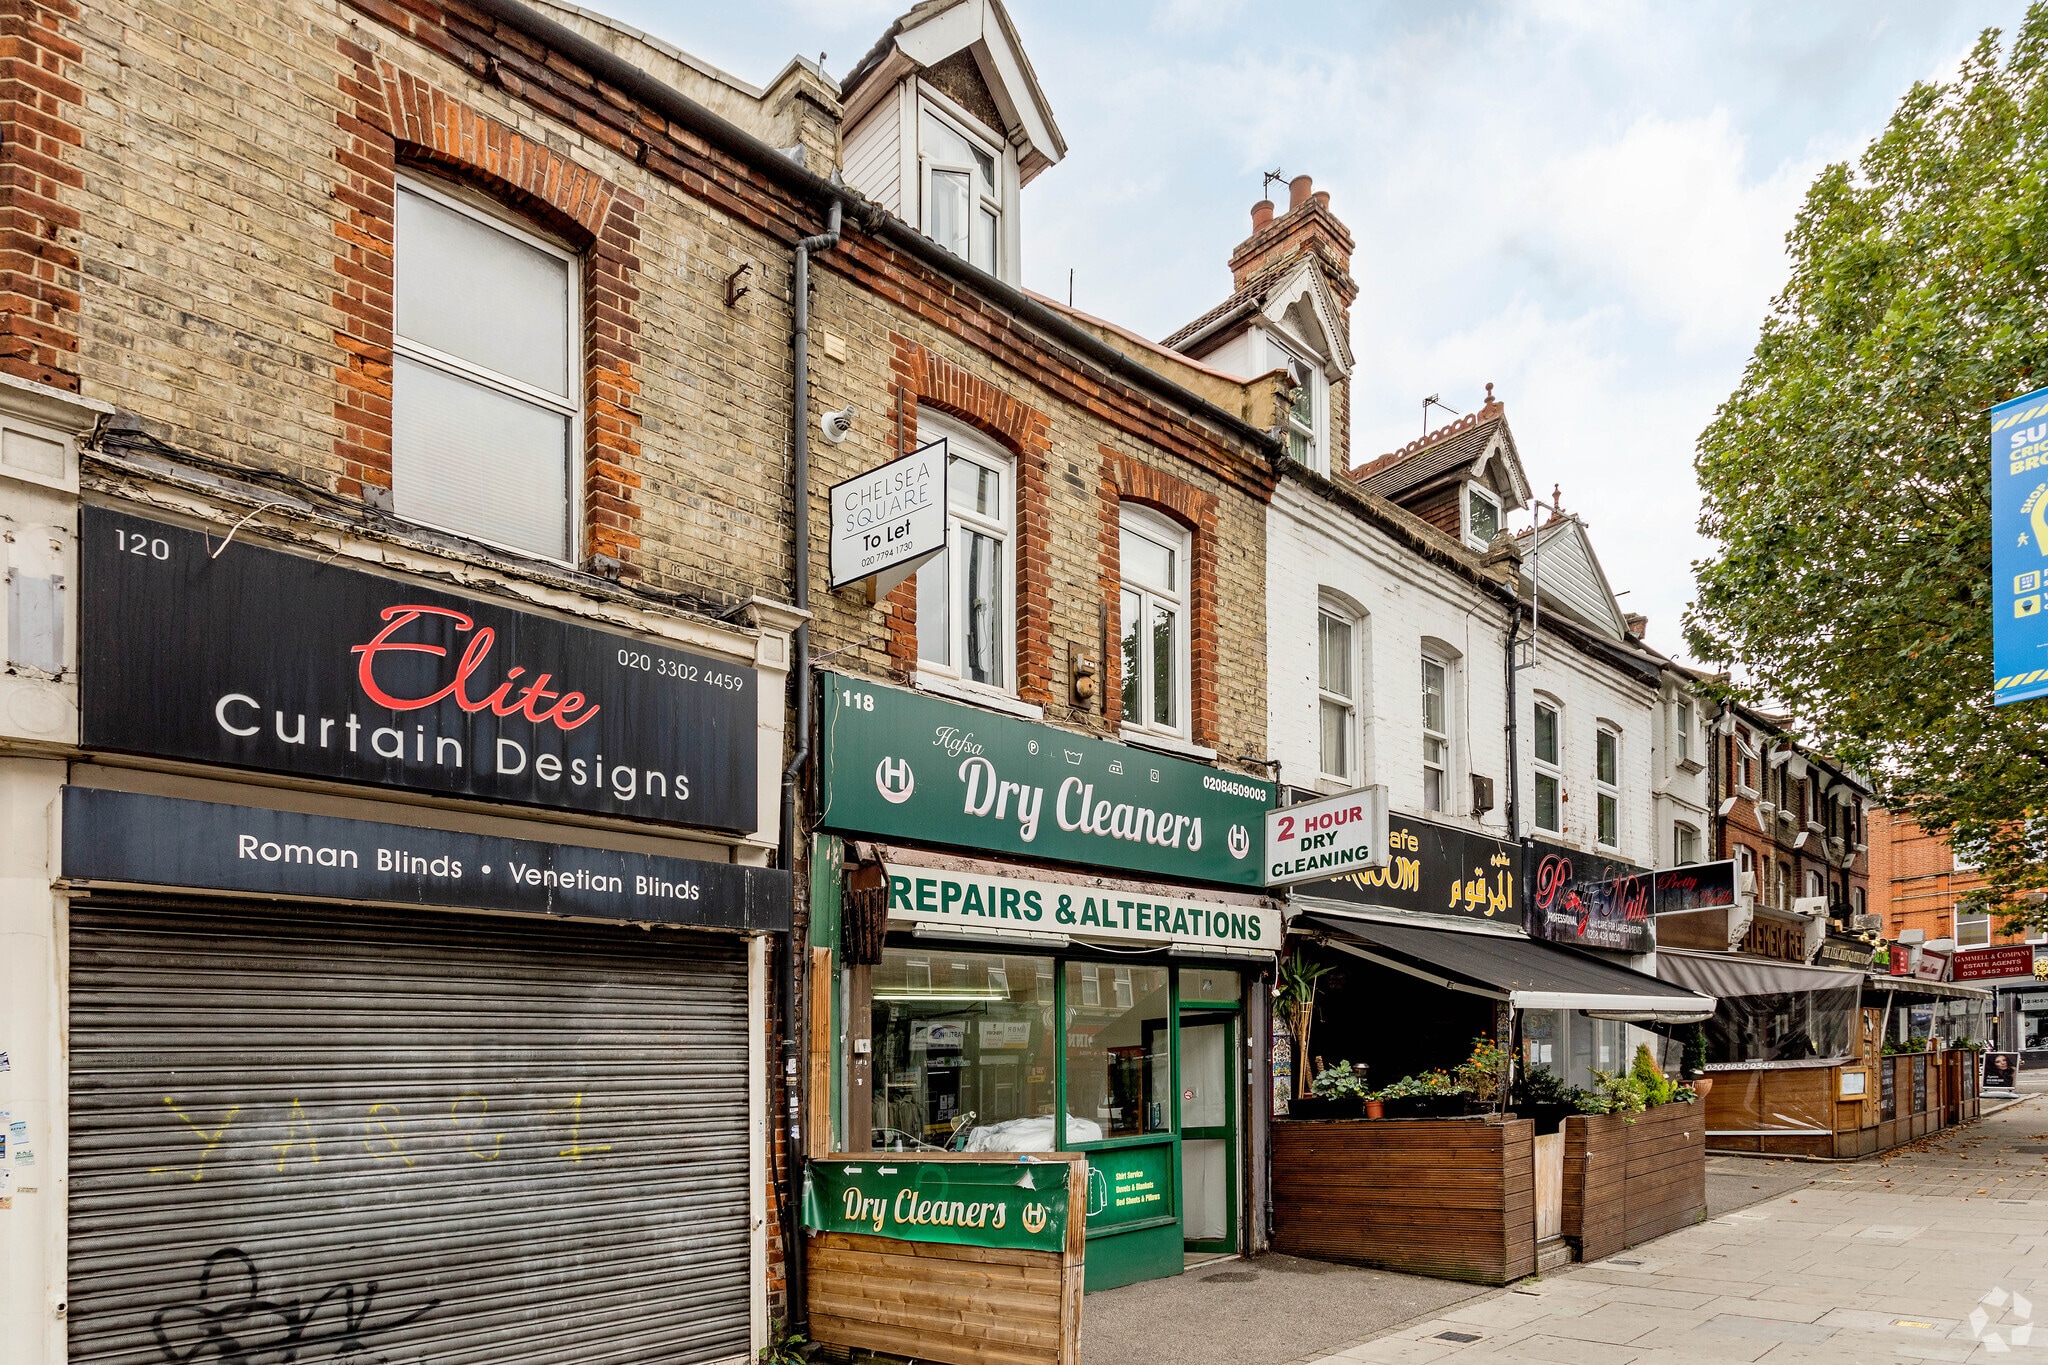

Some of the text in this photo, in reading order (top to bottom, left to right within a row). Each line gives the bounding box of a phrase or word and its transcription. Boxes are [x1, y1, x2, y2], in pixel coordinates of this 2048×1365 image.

[844, 462, 930, 512] CHELSEA
[2020, 483, 2046, 514] SHOP
[846, 483, 928, 533] SQUARE
[115, 528, 169, 562] 120
[863, 519, 911, 551] To Let
[861, 541, 913, 567] 020 7794 1730
[351, 604, 600, 731] Elite
[617, 649, 744, 692] 020 3302 4459
[843, 689, 875, 713] 118
[215, 693, 690, 801] Curtain Designs
[932, 725, 985, 758] Hafsa
[959, 756, 1203, 852] Dry Cleaners
[1203, 775, 1267, 802] 02084509003
[1277, 806, 1363, 843] 2 HOUR
[1389, 828, 1419, 852] afe
[1300, 830, 1338, 852] DRY
[238, 834, 700, 901] Roman Blinds Venetian Blinds
[1271, 845, 1369, 878] CLEANING
[1657, 872, 1698, 892] Pretty
[1691, 887, 1732, 908] Nails
[889, 874, 1043, 922] REPAIRS
[1548, 911, 1579, 928] PROFESSIONAL
[1955, 952, 1989, 963] GAMMELL
[1997, 949, 2031, 959] COMPANY
[1963, 958, 2022, 970] ESTATE AGENTS
[1962, 969, 1978, 977] 020
[1115, 1170, 1144, 1181] Shirt Service
[1136, 1181, 1154, 1190] Blankets
[843, 1187, 886, 1232] Dry
[893, 1187, 1006, 1231] Cleaners
[1116, 1198, 1125, 1206] Bed
[1126, 1196, 1140, 1205] Sheets
[1145, 1193, 1161, 1202] Pillows
